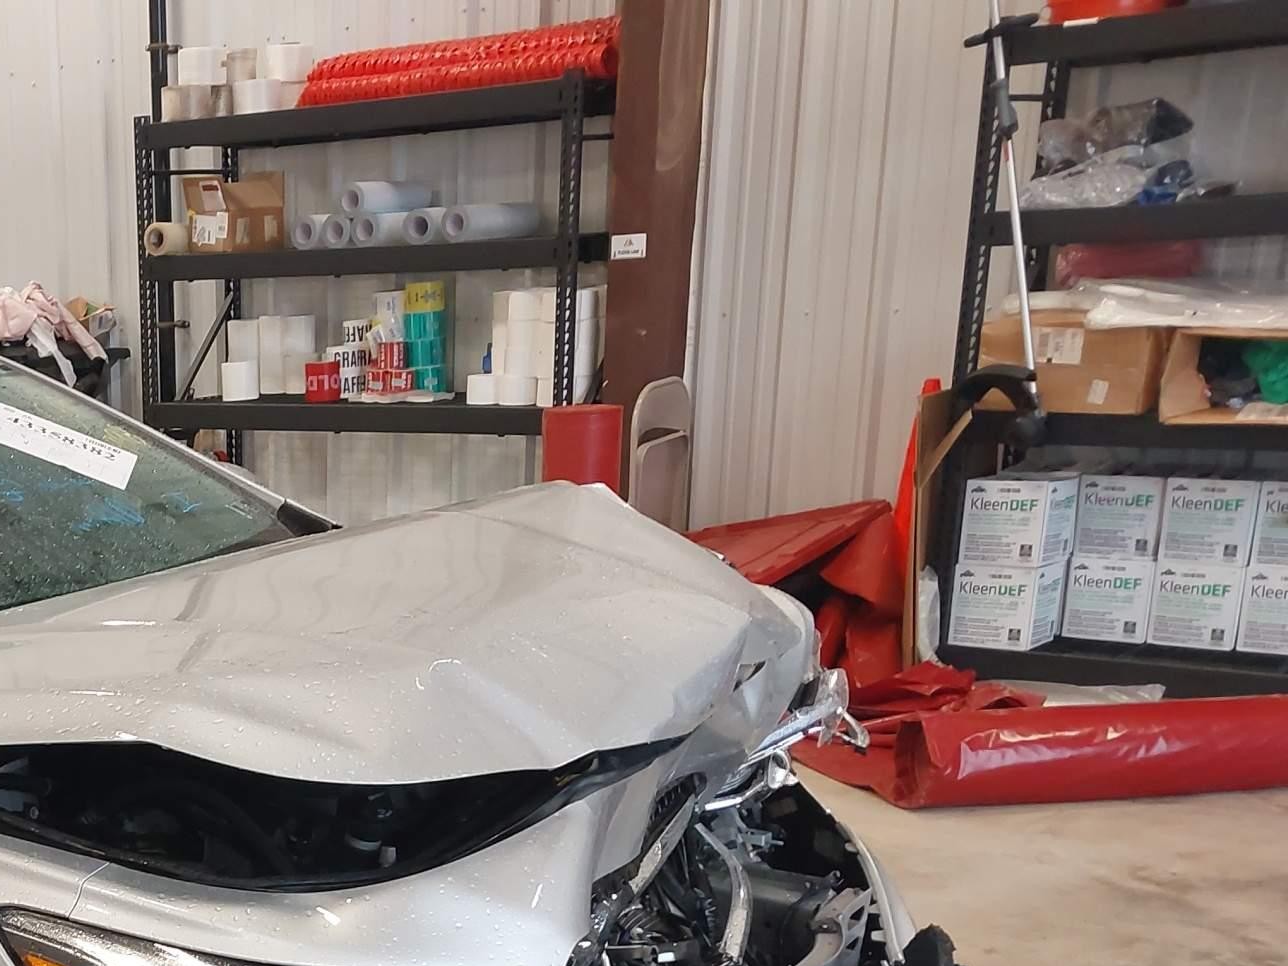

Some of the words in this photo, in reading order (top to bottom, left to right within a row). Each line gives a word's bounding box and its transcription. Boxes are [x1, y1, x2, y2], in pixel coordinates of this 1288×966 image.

[970, 498, 1039, 512] KleenDEF
[1084, 493, 1154, 507] KleenDEF
[1171, 496, 1244, 511] KleenDEF
[959, 581, 1028, 597] KleenDEF
[1073, 574, 1143, 590] KleenDEF
[1159, 580, 1232, 597] KleenDEF
